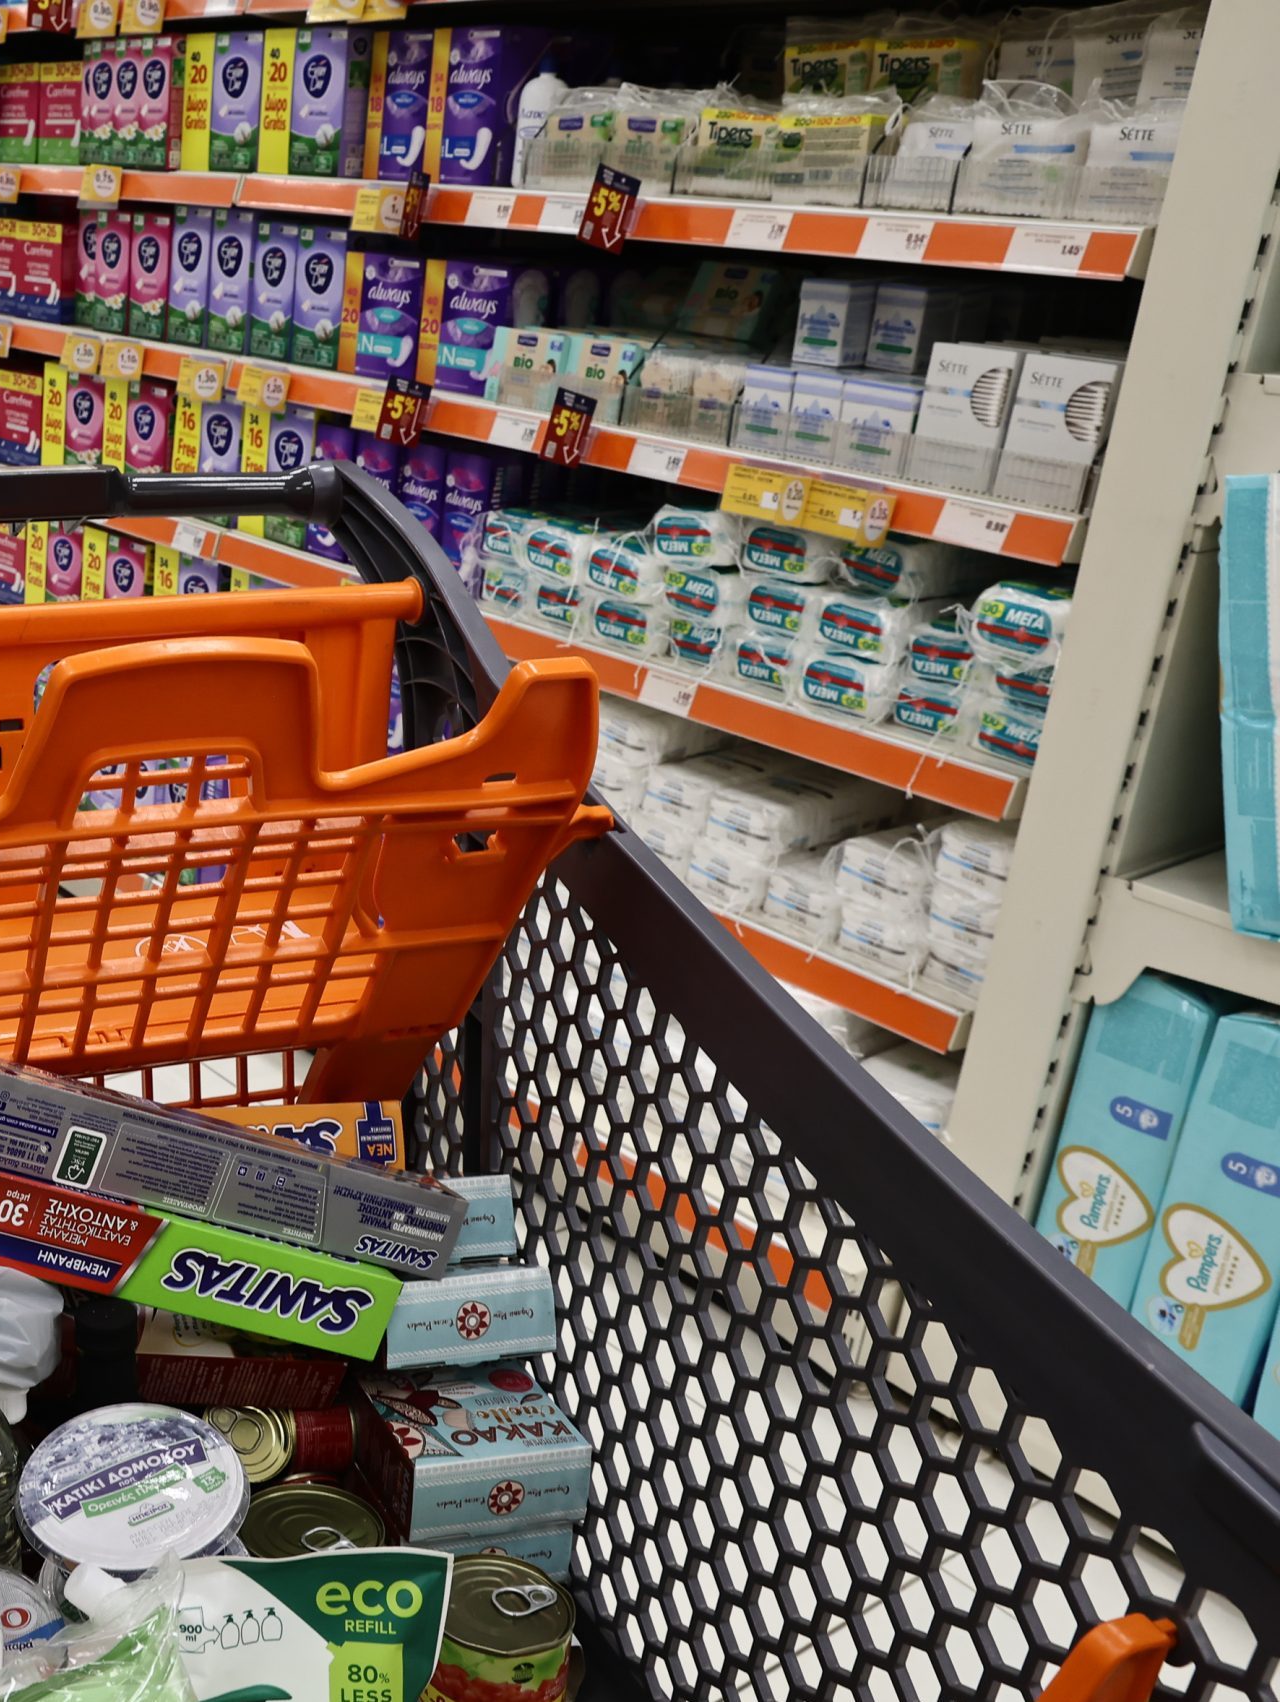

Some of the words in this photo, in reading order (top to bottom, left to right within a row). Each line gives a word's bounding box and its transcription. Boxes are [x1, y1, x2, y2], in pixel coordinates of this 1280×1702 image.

[790, 57, 838, 79] Tipers
[878, 53, 930, 76] Tipers
[388, 66, 426, 90] always
[450, 64, 493, 90] always
[431, 97, 443, 112] 18
[708, 121, 753, 143] Tipers
[593, 188, 622, 217] -5%
[24, 242, 53, 257] Carefree
[368, 282, 411, 307] always
[450, 291, 498, 319] always
[422, 318, 439, 334] 20
[3, 390, 32, 407] Carefree
[387, 394, 415, 419] -5%
[554, 409, 581, 436] -5%
[178, 439, 197, 458] Free
[403, 482, 438, 504] always
[446, 491, 483, 514] always
[28, 559, 43, 575] Free
[85, 577, 100, 593] Free
[686, 579, 715, 599] ΜΕΓΑ
[1005, 608, 1046, 630] ΜΕΓΑ
[824, 625, 855, 646] ΜΕΓΑ
[914, 659, 950, 676] ΜΕΓΑ
[808, 684, 839, 701] ΜΕΓΑ
[1116, 1103, 1132, 1118] 5
[367, 1143, 392, 1156] ΝΕΑ
[20, 1161, 44, 1174] Πάντα
[1228, 1159, 1247, 1175] 5
[5, 1187, 31, 1203] μέτρα
[333, 1184, 364, 1200] ΧΡΗΣΗ!
[1080, 1173, 1112, 1231] Pampers
[357, 1202, 393, 1219] ΑΝΤΟΧΗΣ
[362, 1192, 416, 1213] ΚΑΘΗΜΕΡΙΝΗ
[44, 1195, 127, 1234] ΑΝΤΟΧΗΣ
[359, 1213, 392, 1230] ΥΨΗΛΗΣ
[392, 1211, 405, 1221] ΚΑΙ
[404, 1214, 447, 1233] ΠΟΙΟΤΗΤΑΣ
[36, 1222, 88, 1248] ΜΕΓΑΛΗΣ
[40, 1210, 131, 1249] ΕΛΑΣΤΙΚΟΤΗΤΑΣ
[128, 1219, 138, 1231] &
[392, 1221, 444, 1242] ΑΛΟΥΜΙΝΟΧΑΡΤΟ
[353, 1230, 439, 1272] SANITAS
[36, 1246, 110, 1280] ΜΕΜΒΡΑΝΗ
[1187, 1232, 1223, 1293] Pampers
[162, 1248, 377, 1334] SANITAS
[509, 1307, 534, 1319] Organic
[50, 1478, 106, 1516] ΚΑΤΙΚΙ
[108, 1443, 196, 1484] ΔΟΜΟΚΟΥ
[87, 1492, 136, 1513] Ορεινές
[315, 1580, 423, 1618] eco
[179, 1624, 202, 1635] 900
[345, 1619, 397, 1635] REFILL
[185, 1633, 197, 1643] ml
[347, 1664, 390, 1684] 80%
[340, 1688, 392, 1702] LESS
